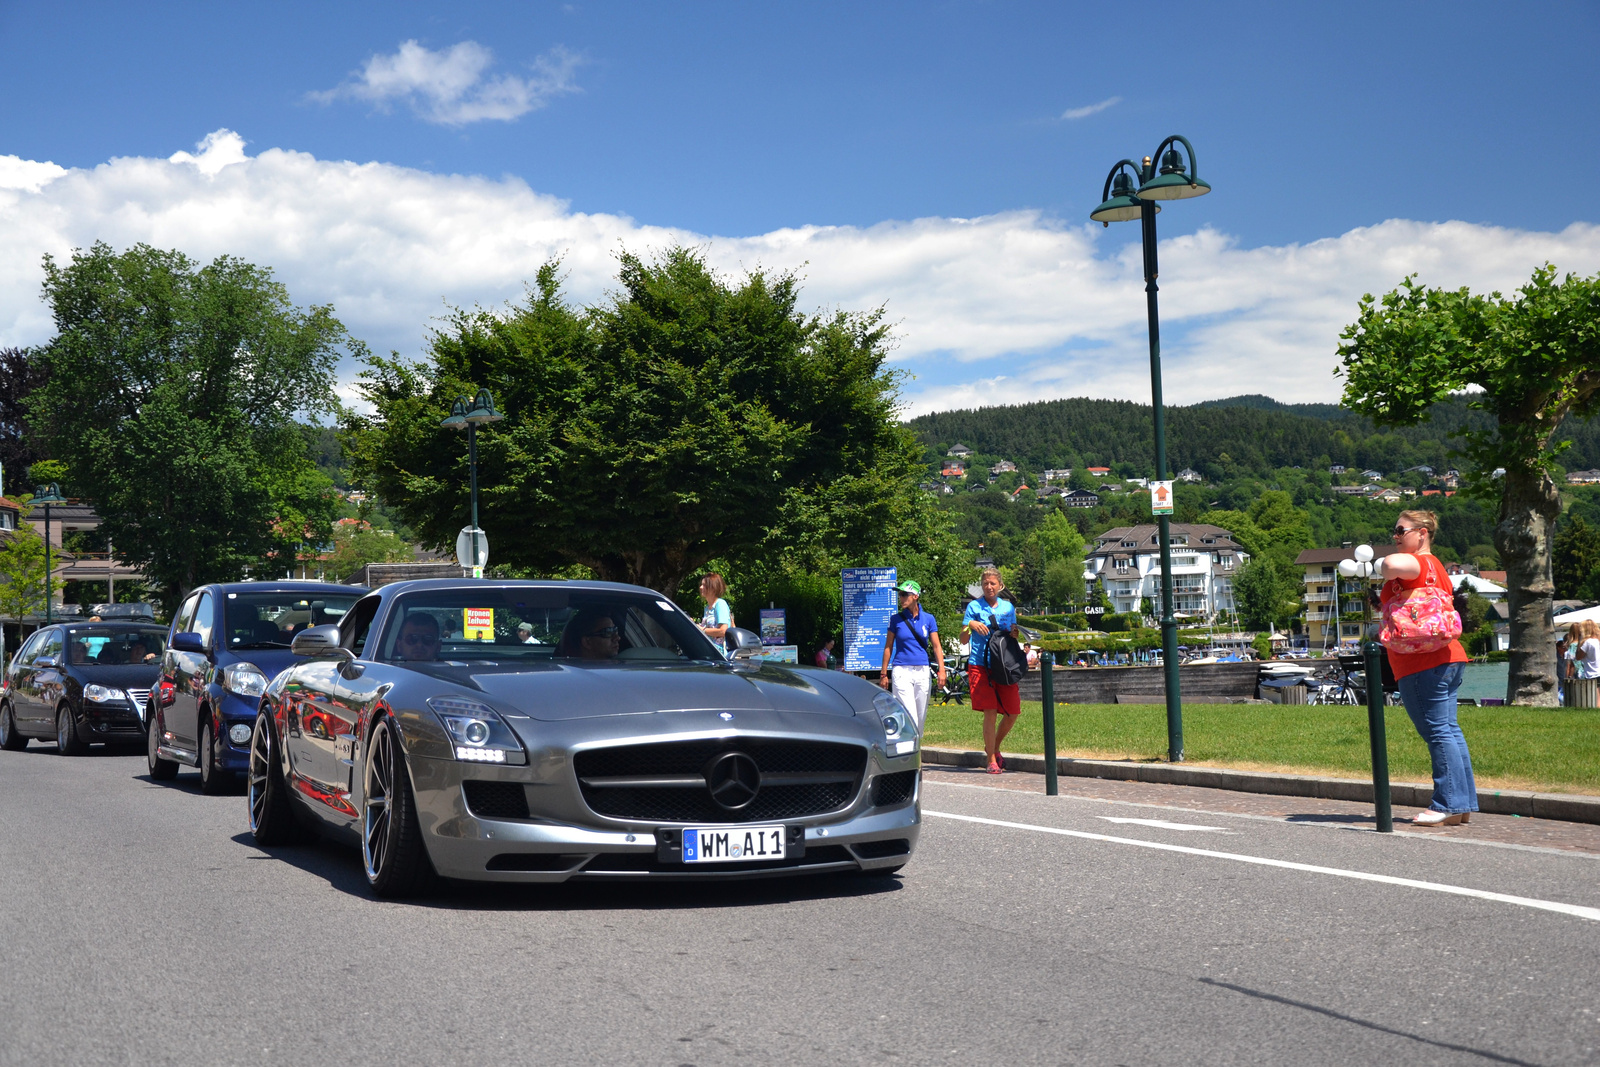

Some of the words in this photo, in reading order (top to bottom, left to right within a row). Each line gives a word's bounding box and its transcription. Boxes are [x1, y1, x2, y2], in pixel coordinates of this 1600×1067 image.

[1085, 606, 1105, 614] CASIN
[468, 617, 490, 625] Zeitung
[701, 833, 729, 858] WM
[743, 831, 782, 856] AI1
